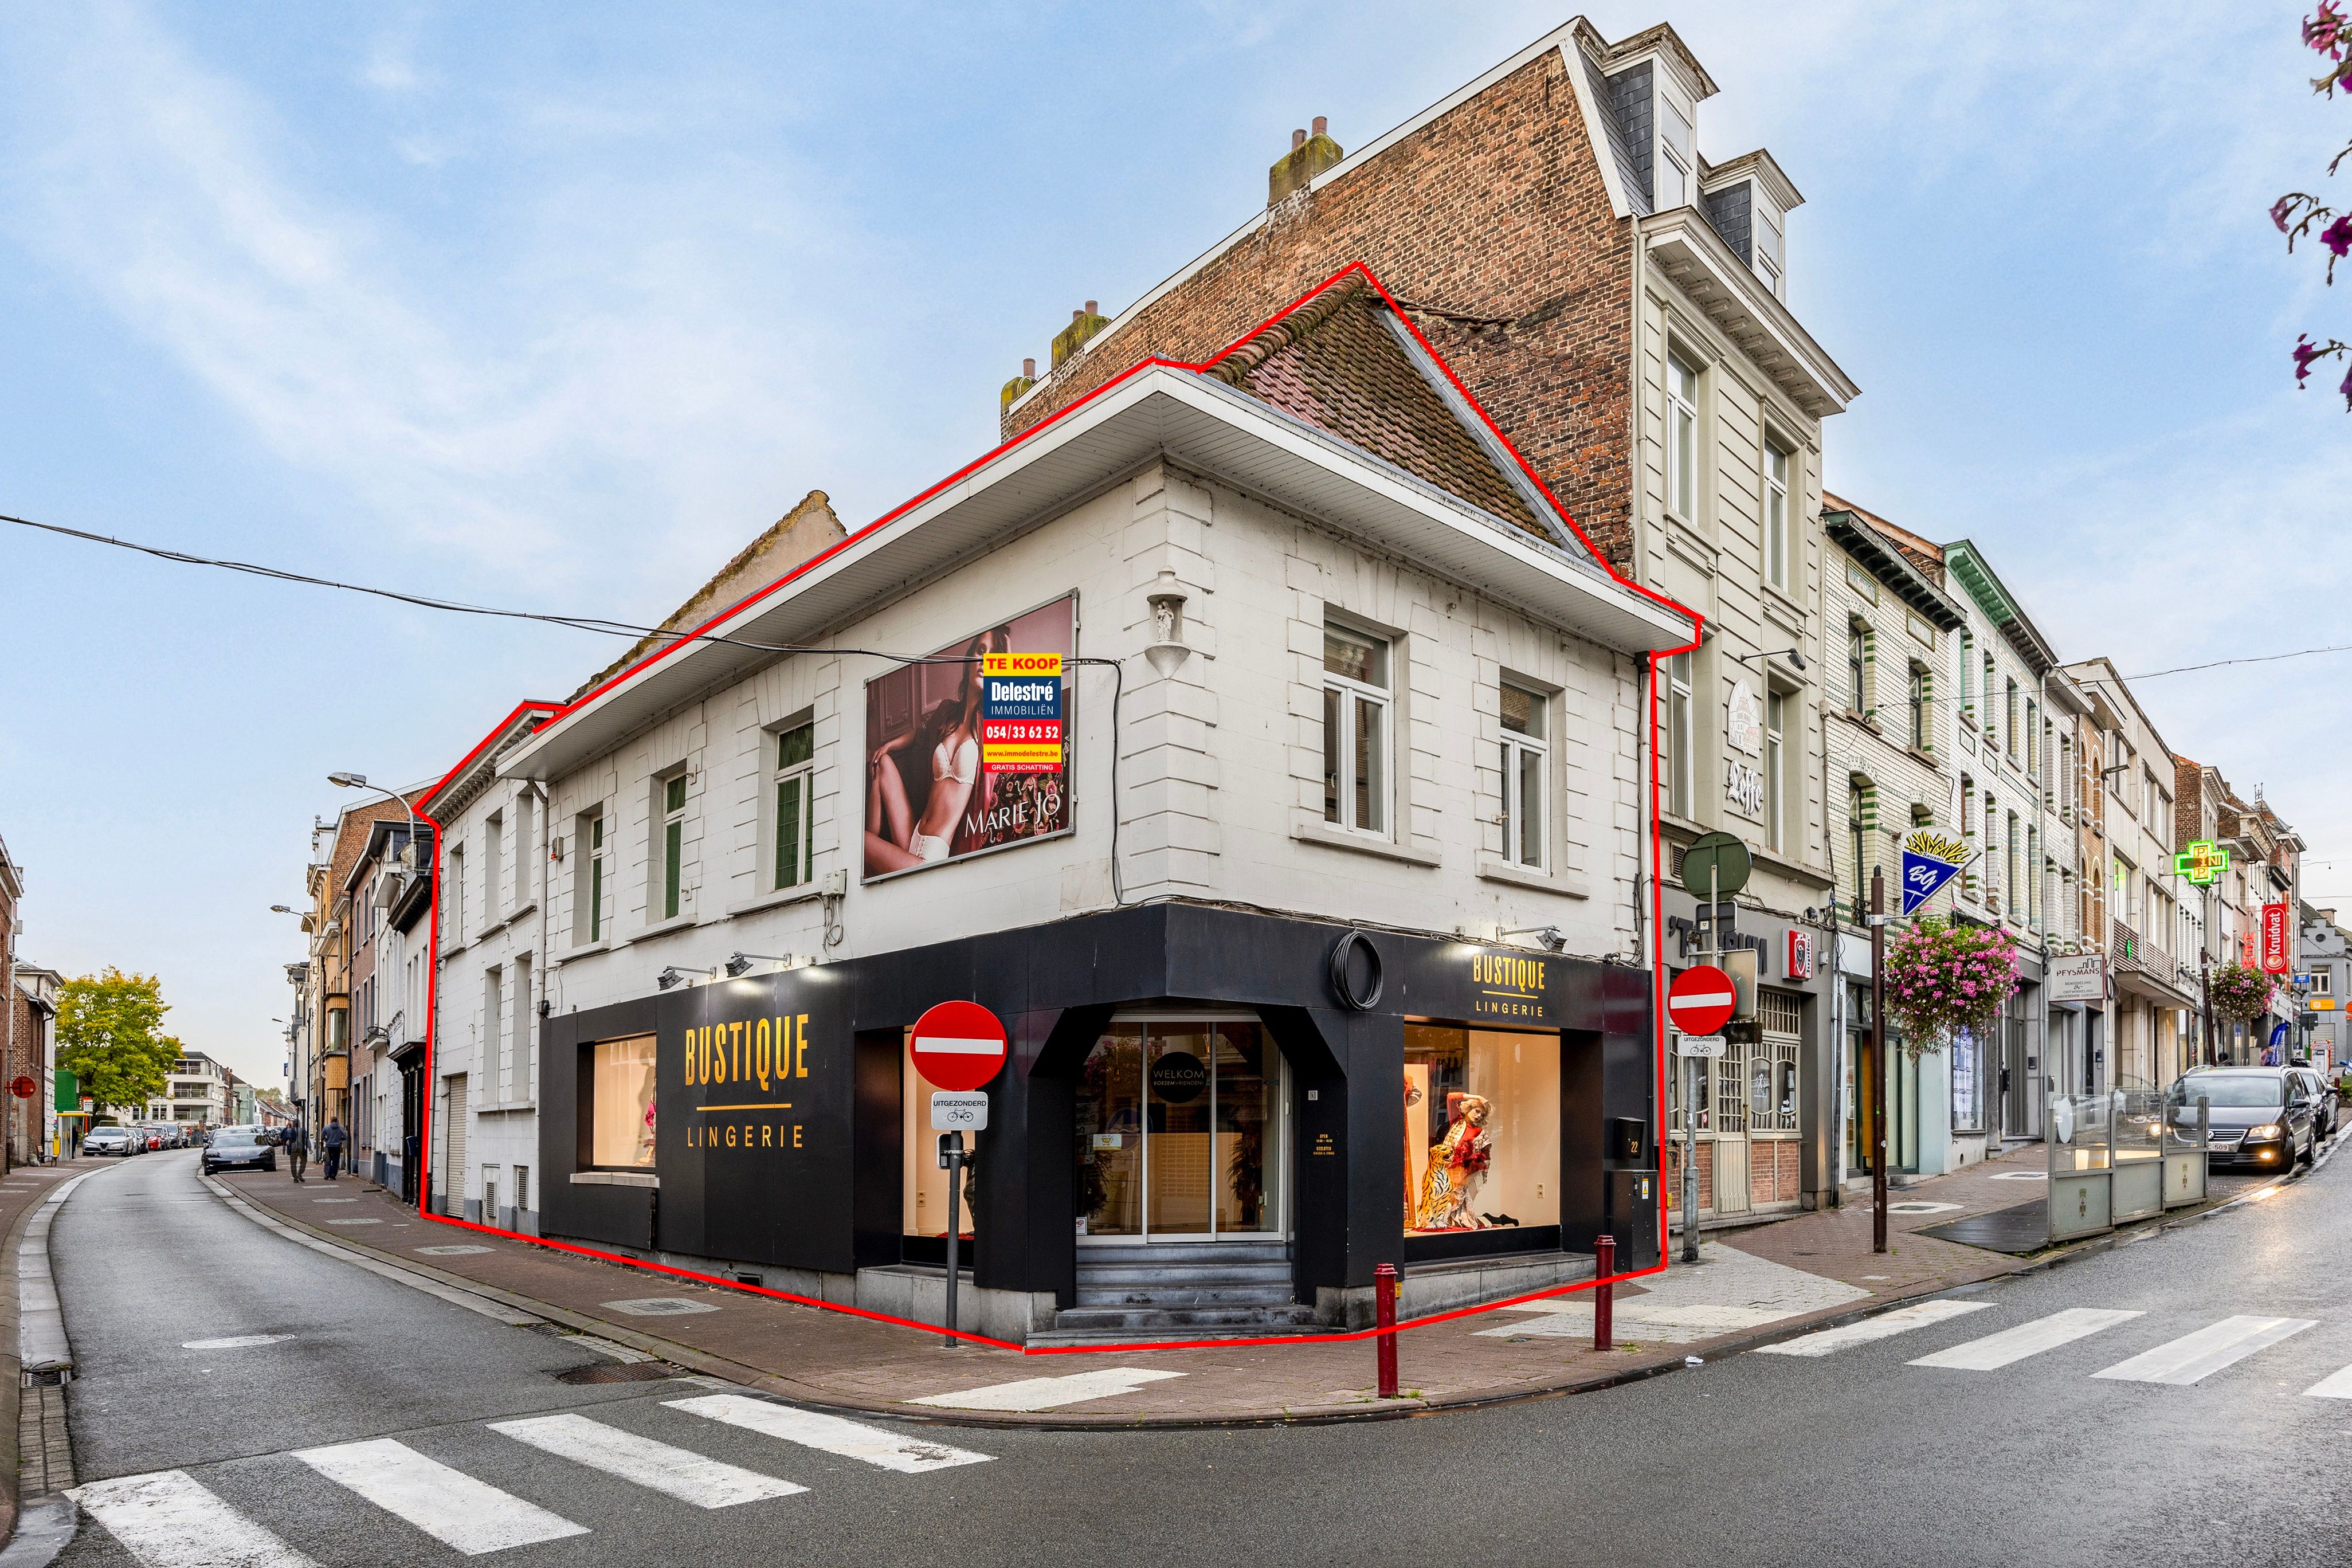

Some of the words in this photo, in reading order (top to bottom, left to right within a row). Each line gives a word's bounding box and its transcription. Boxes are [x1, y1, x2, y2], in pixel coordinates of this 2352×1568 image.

[1726, 758, 1762, 815] Leffe
[965, 801, 1029, 837] MARIE
[1036, 792, 1060, 824] JO
[1908, 865, 1938, 891] BG
[2268, 912, 2280, 954] Kruidvat
[1473, 954, 1545, 992] BUSTIQUE
[1476, 1001, 1543, 1017] LINGERIE
[685, 1014, 809, 1091] BUSTIQUE
[1153, 1070, 1204, 1079] WELKOM
[688, 1126, 802, 1147] LINGERIE
[1631, 1141, 1638, 1153] 22
